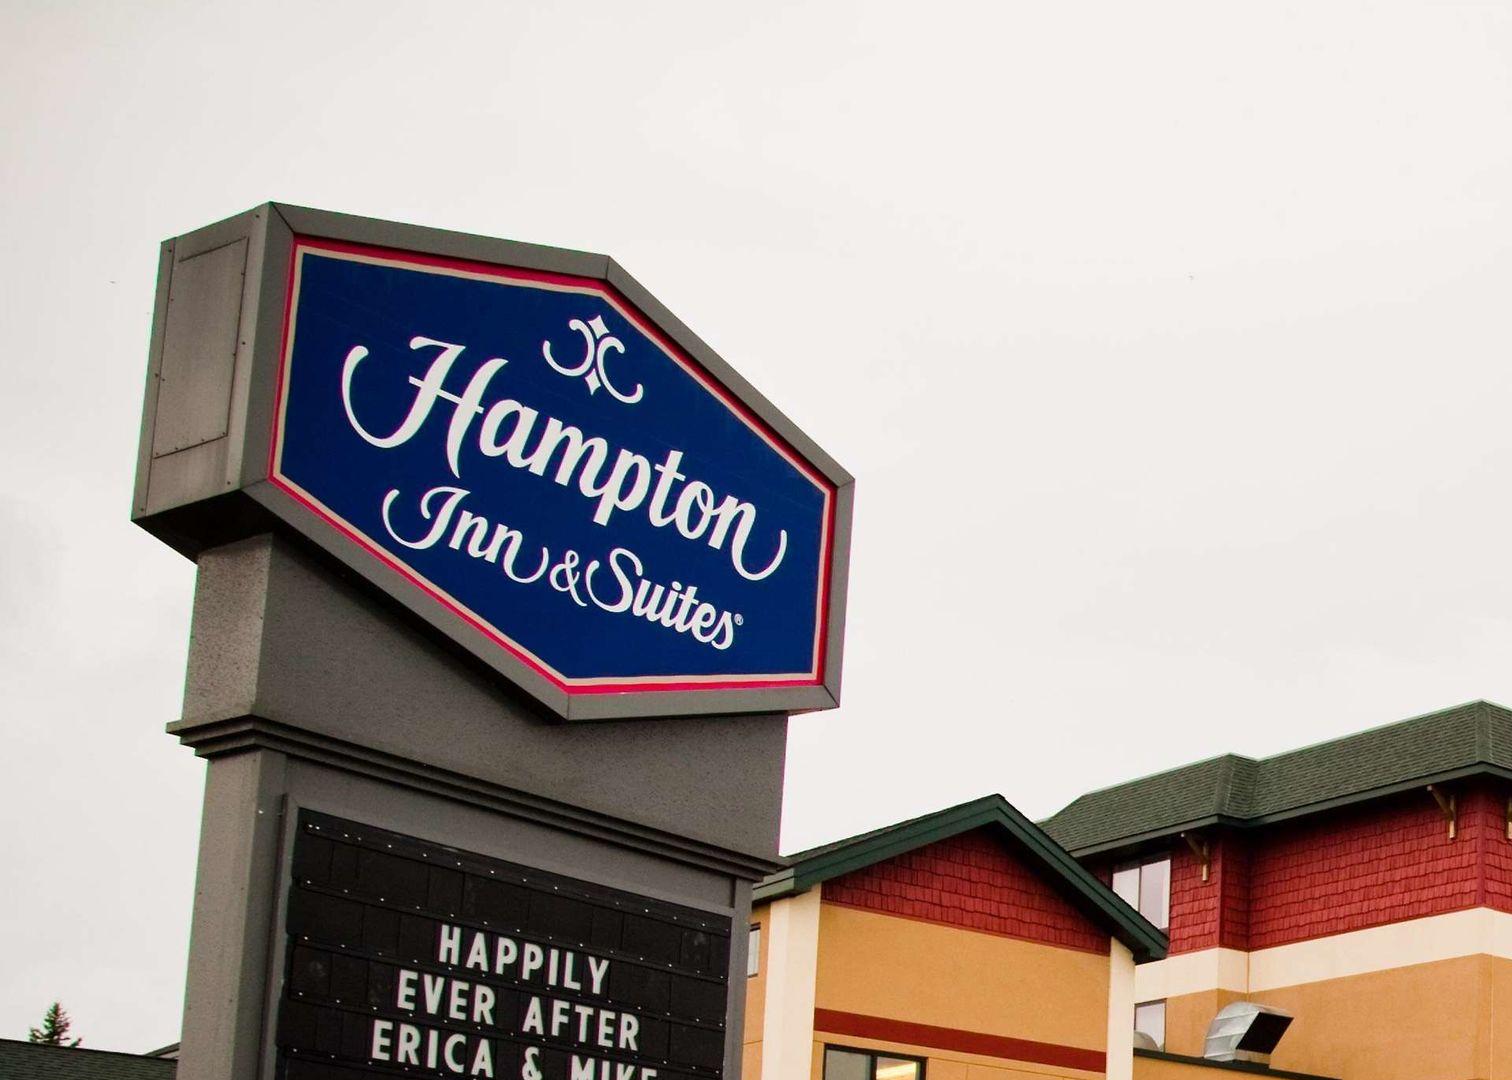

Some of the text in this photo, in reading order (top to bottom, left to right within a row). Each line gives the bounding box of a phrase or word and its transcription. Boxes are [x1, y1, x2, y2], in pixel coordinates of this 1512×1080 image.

[341, 336, 788, 581] Hampton
[382, 486, 549, 584] Inn
[549, 549, 588, 607] &
[438, 924, 610, 995] HAPPILY
[371, 1019, 494, 1078] ERICA
[396, 969, 640, 1051] EVER AFTER
